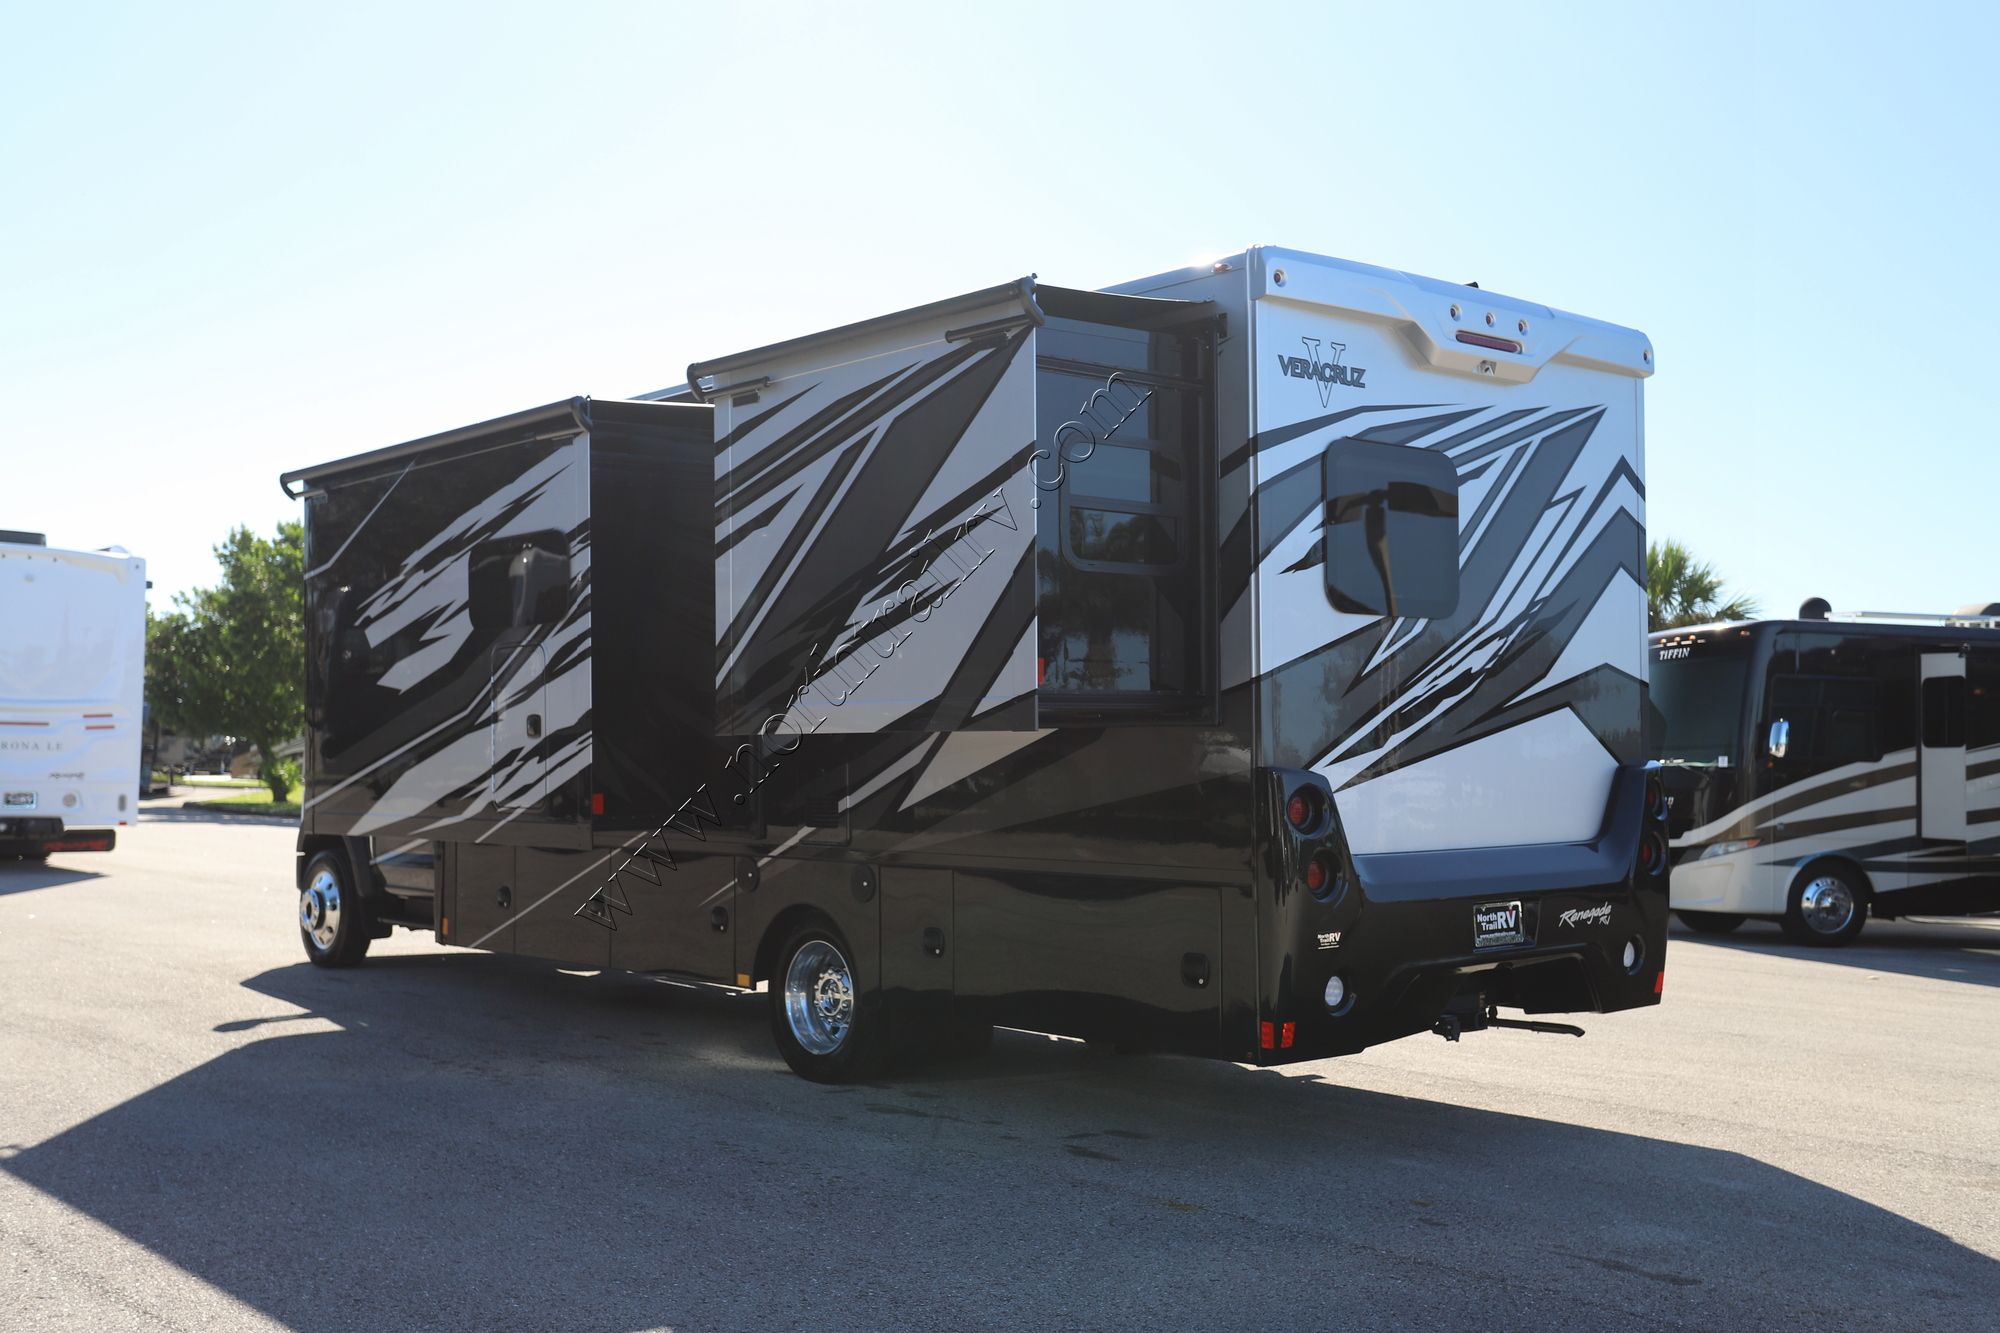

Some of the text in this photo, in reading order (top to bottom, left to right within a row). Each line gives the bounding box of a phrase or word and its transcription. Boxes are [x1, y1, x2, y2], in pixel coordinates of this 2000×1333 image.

[1278, 354, 1366, 388] VERACRUZ
[1659, 647, 1690, 660] TIFFIN
[1477, 912, 1497, 922] North
[1497, 910, 1516, 929] RV
[1559, 901, 1612, 928] Renegade
[1481, 921, 1497, 931] Trail
[1329, 932, 1341, 942] RV
